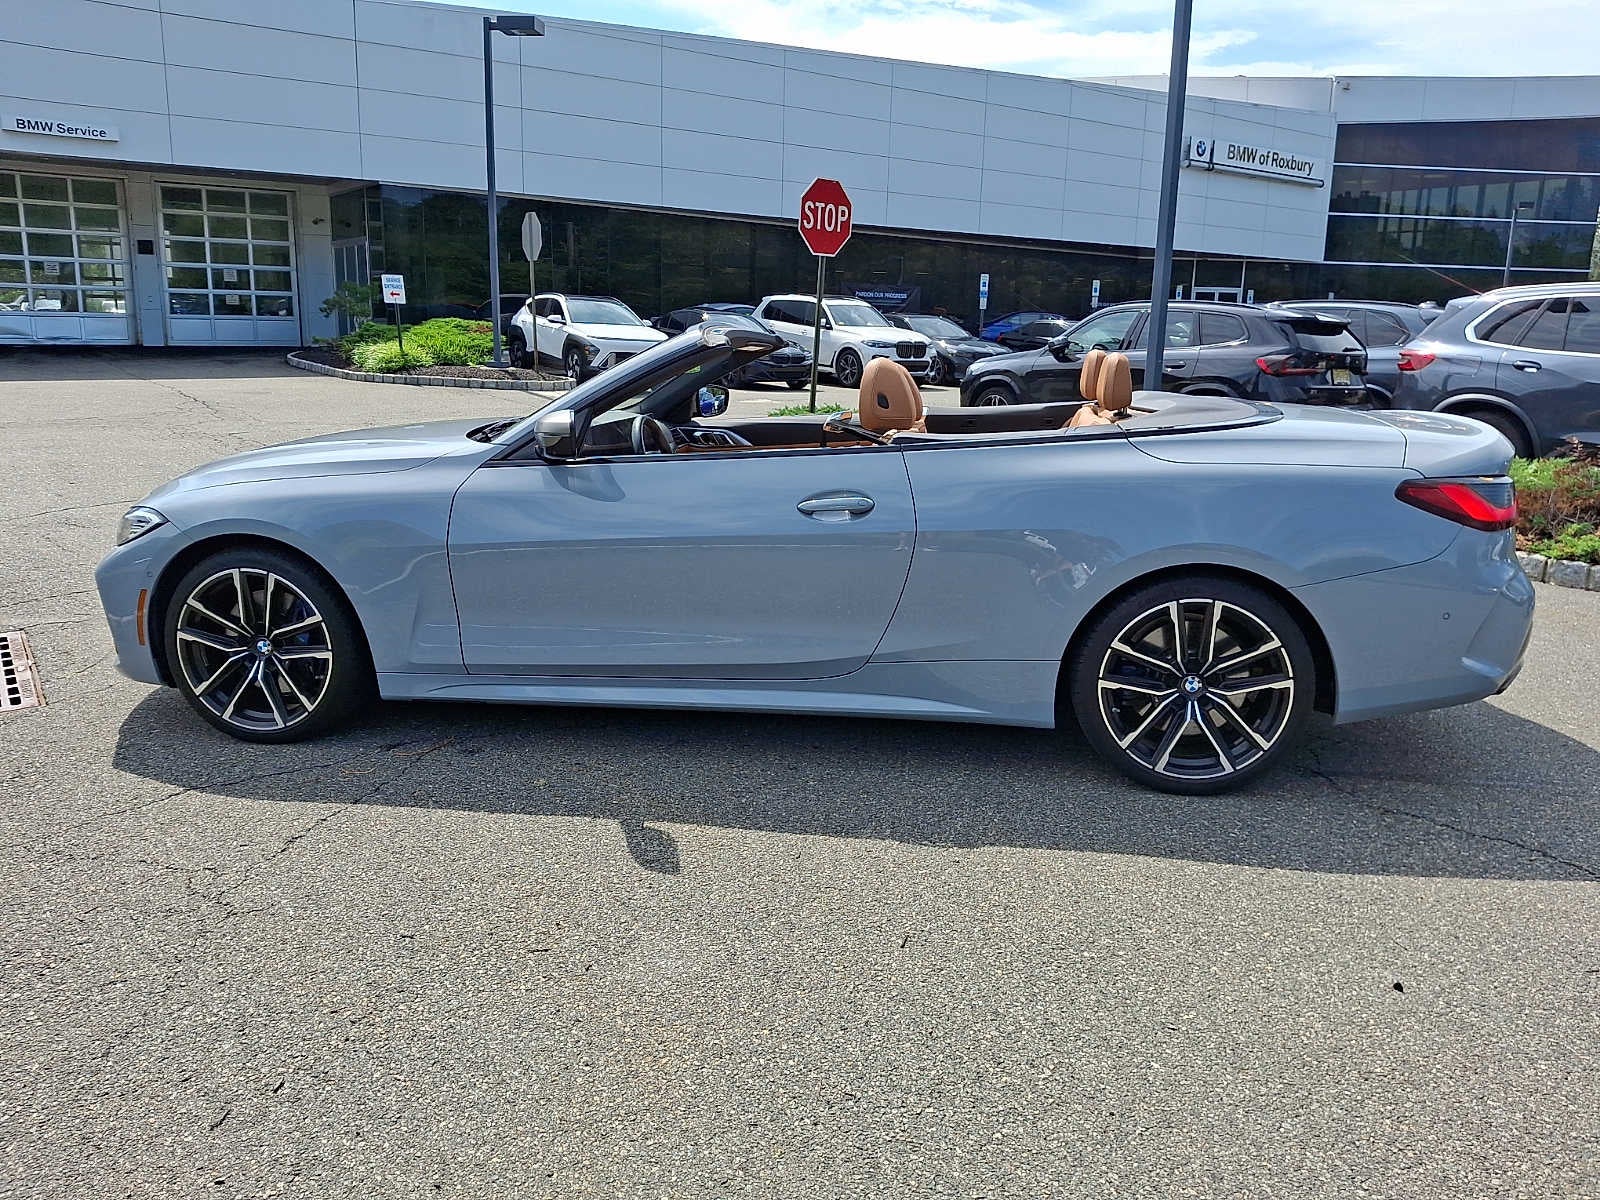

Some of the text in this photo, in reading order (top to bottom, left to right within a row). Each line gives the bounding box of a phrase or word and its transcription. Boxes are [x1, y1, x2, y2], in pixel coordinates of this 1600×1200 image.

[16, 118, 107, 138] BMW Service
[1227, 144, 1314, 176] BMW of Roxbury
[803, 201, 849, 233] STOP
